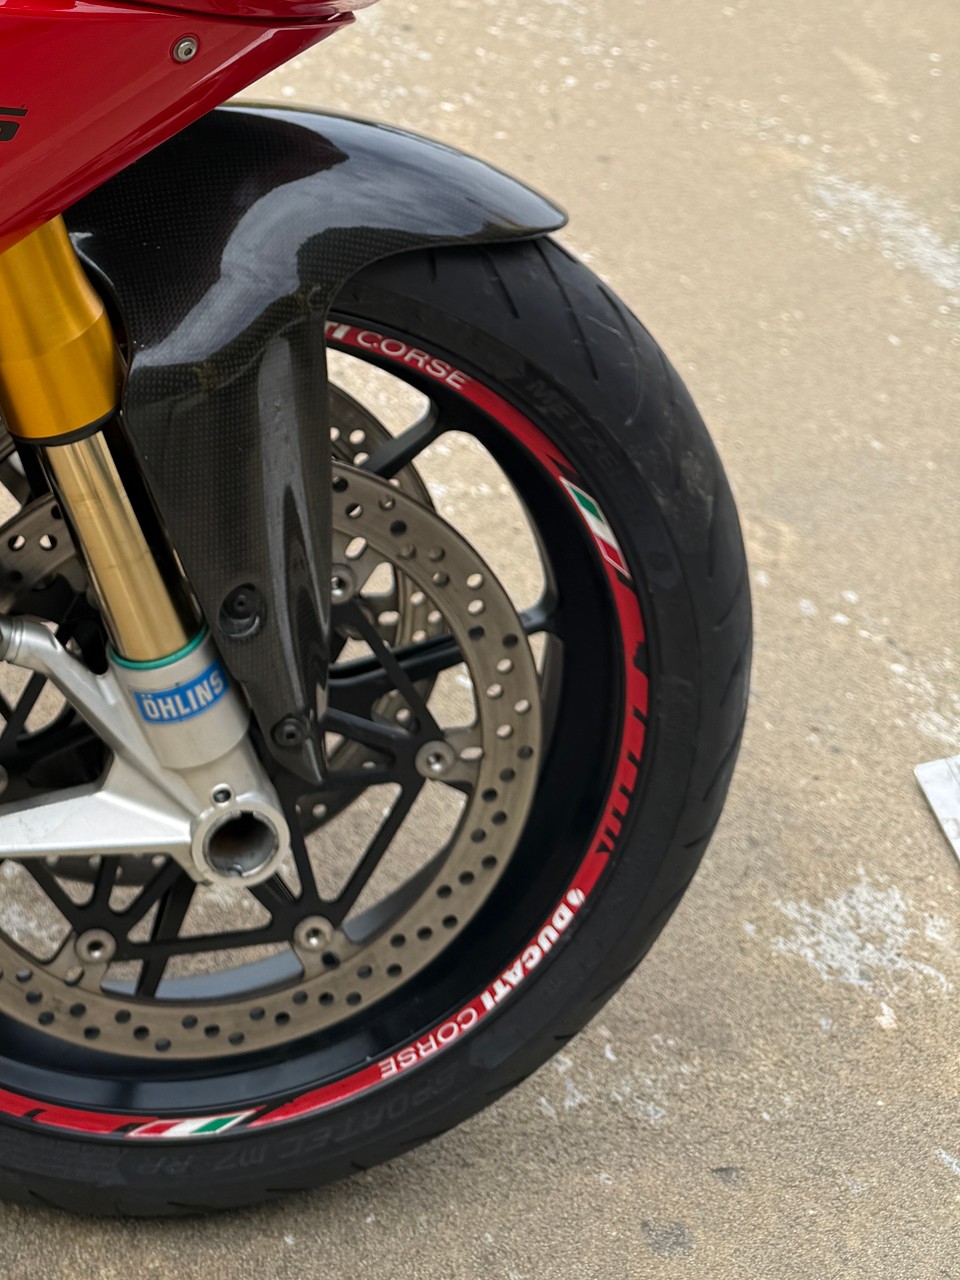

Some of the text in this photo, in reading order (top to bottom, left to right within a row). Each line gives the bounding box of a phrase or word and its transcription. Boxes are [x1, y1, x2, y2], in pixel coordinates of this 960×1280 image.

[356, 329, 474, 391] CORSE
[140, 670, 224, 719] ÖHLINS
[377, 903, 574, 1080] DUCATI CORSE
